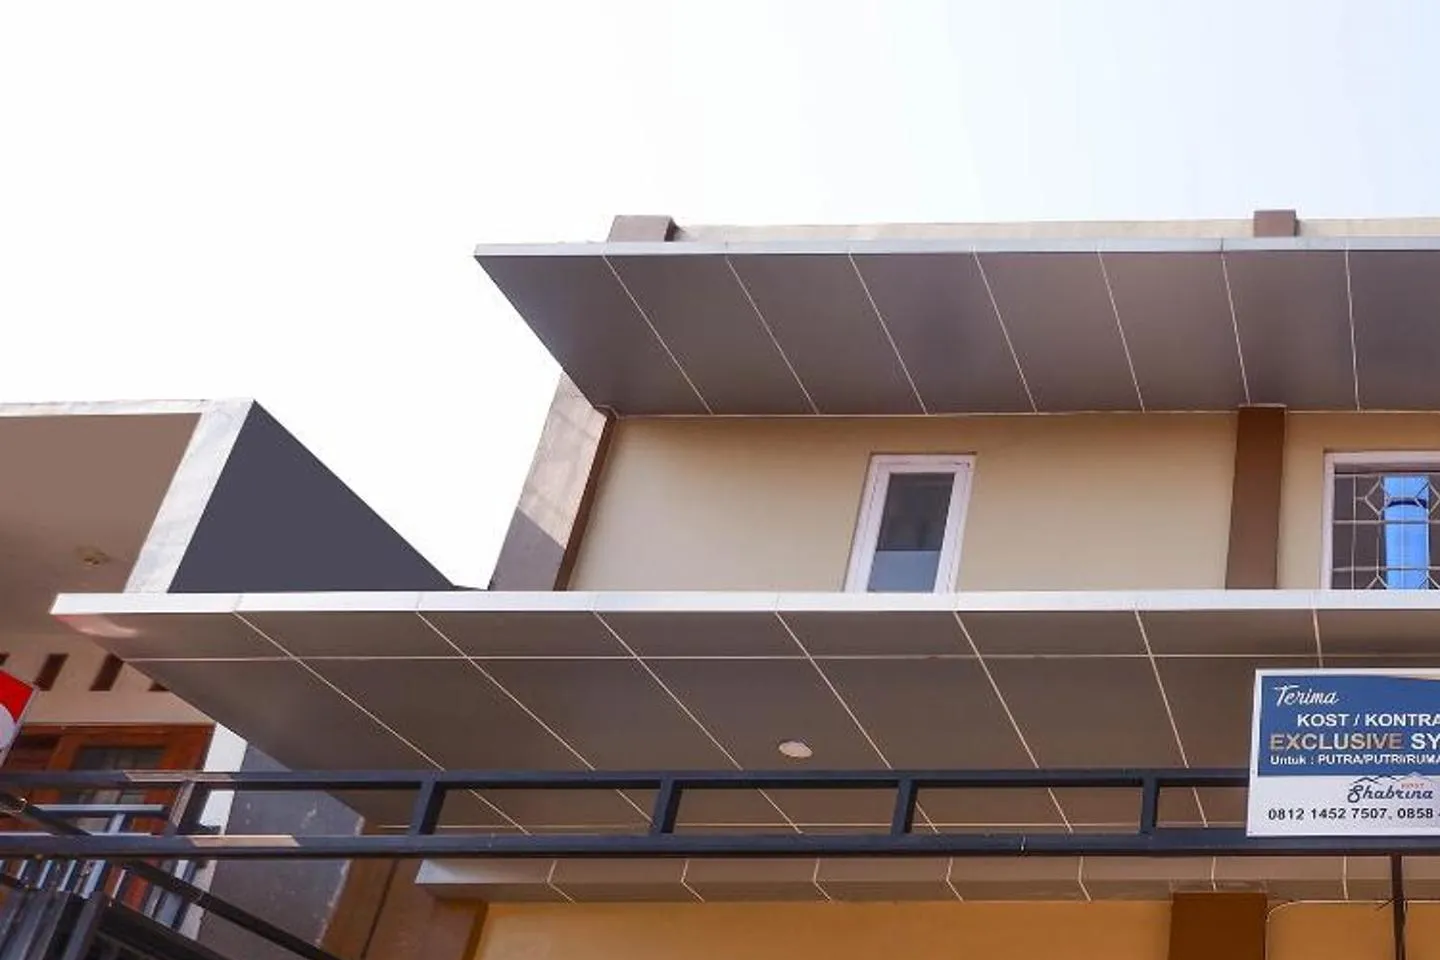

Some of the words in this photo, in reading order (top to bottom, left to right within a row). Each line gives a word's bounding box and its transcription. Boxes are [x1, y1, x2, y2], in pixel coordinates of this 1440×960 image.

[1274, 684, 1339, 706] Terima
[1297, 713, 1350, 727] KOST
[1353, 713, 1360, 727] /
[1269, 733, 1404, 751] EXCLUSIVE
[1270, 755, 1306, 765] Untuk
[1347, 784, 1433, 804] Shabrina
[1268, 808, 1305, 820] 0812
[1311, 808, 1346, 820] 1452
[1397, 807, 1433, 819] 0858
